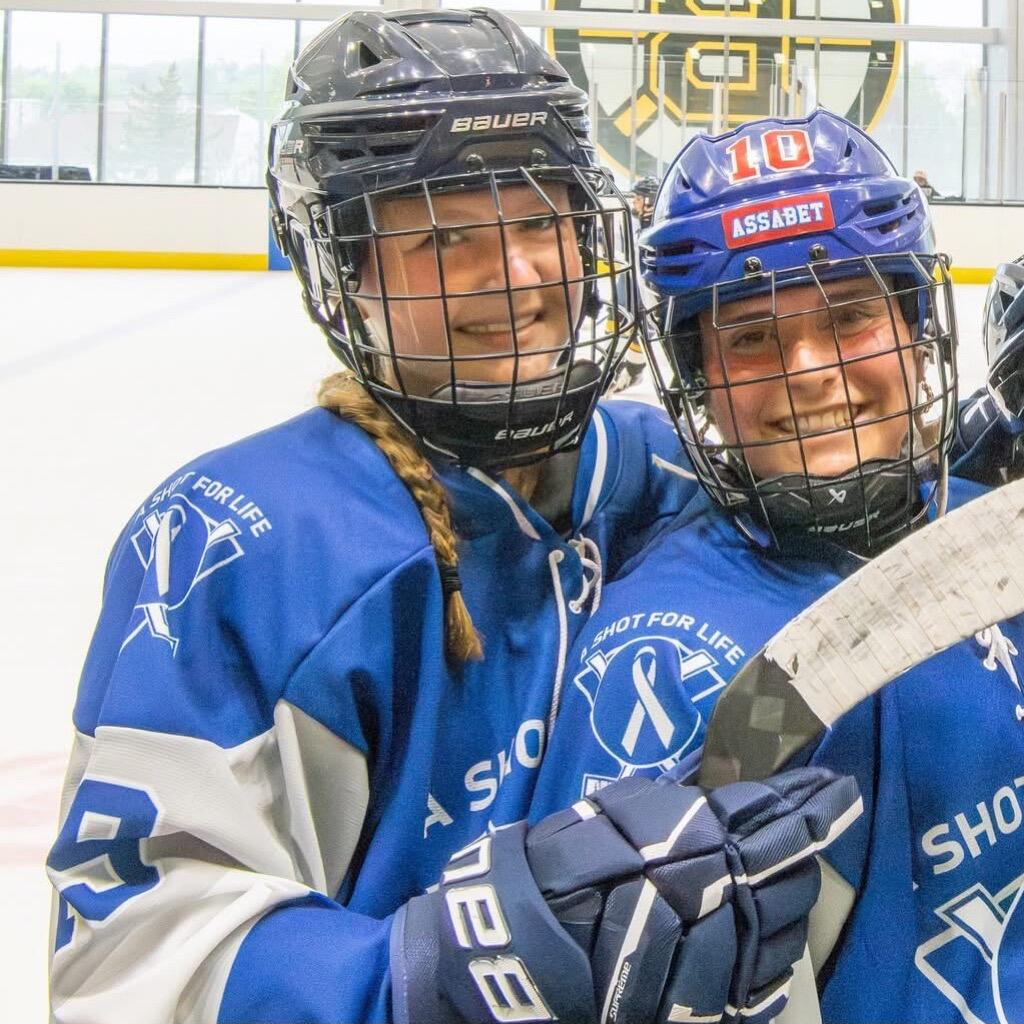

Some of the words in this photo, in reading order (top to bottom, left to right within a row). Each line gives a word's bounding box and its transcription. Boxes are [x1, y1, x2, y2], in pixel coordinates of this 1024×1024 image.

[450, 111, 548, 133] BAUER
[726, 129, 814, 184] 10
[732, 202, 824, 239] ASSABET
[150, 471, 196, 509] SHOT
[192, 475, 235, 505] FOR
[228, 494, 273, 538] LIFE
[591, 613, 646, 650] SHOT
[647, 611, 696, 631] FOR
[696, 622, 746, 666] LIFE
[464, 719, 545, 812] SHO
[426, 820, 558, 1023] BAU
